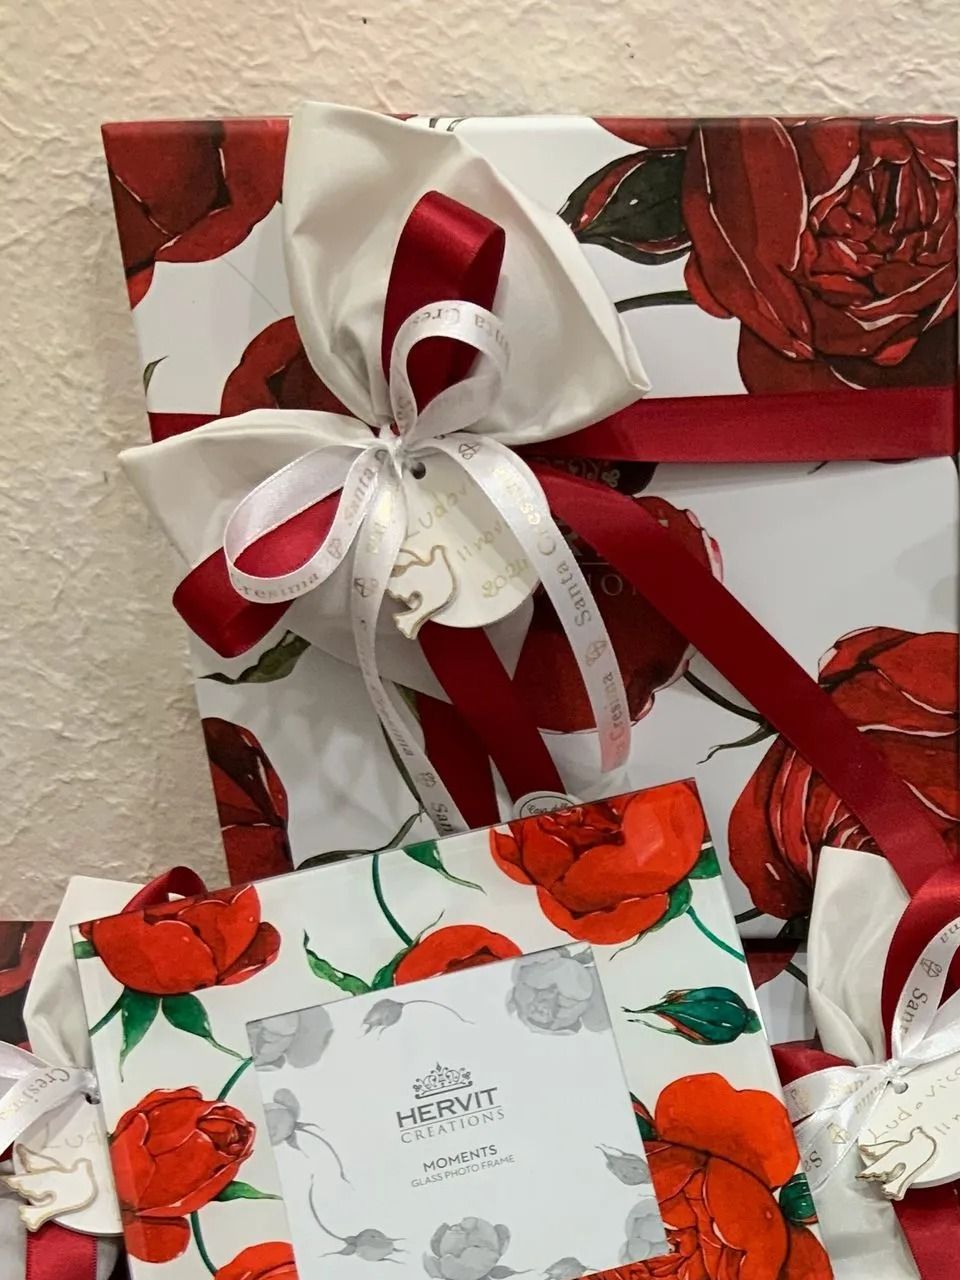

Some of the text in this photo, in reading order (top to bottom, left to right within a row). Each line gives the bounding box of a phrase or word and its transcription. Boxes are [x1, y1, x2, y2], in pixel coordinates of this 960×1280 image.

[557, 562, 593, 627] Santa
[431, 801, 454, 833] San
[899, 987, 929, 1035] Sant
[395, 1086, 499, 1129] HERVIT
[400, 1108, 506, 1144] CREATIONS
[410, 1154, 516, 1188] GLASS PHOTO FRAME
[422, 1144, 498, 1173] MOMENTS
